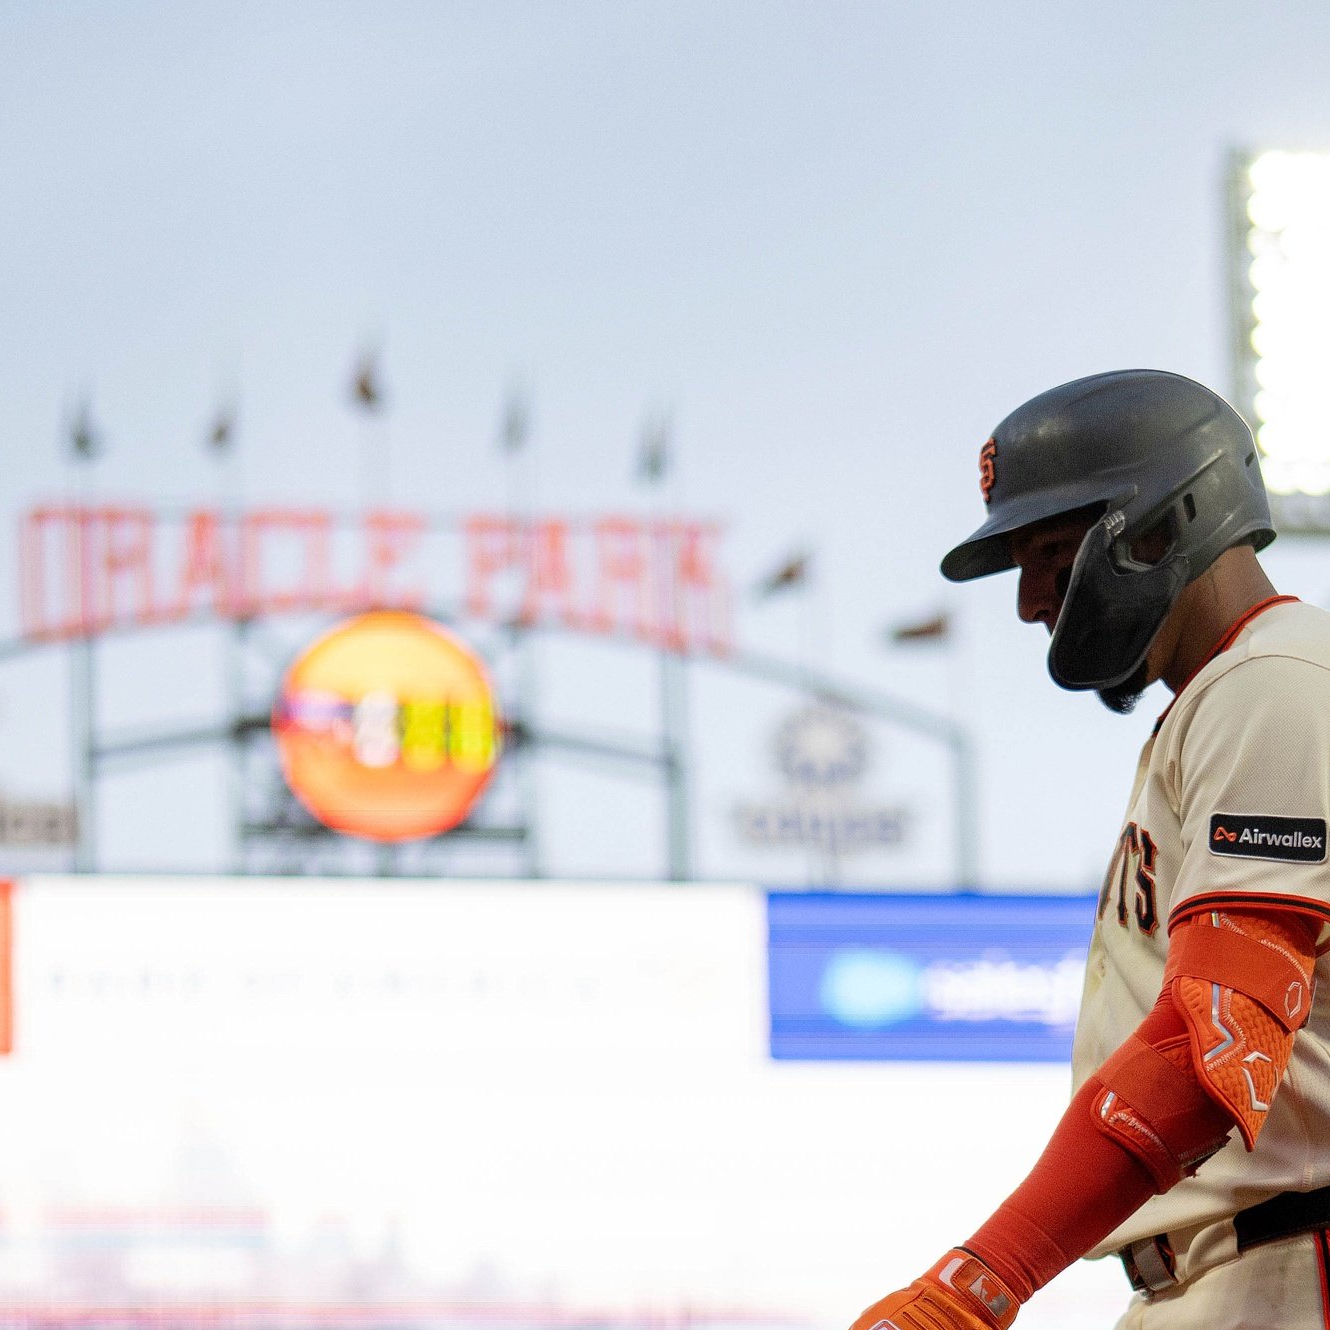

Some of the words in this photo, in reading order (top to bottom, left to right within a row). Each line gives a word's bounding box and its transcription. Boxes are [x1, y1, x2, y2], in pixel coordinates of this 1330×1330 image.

[22, 505, 428, 642] ORACLE
[464, 512, 733, 656] PARK
[1238, 827, 1323, 850] Airwallex
